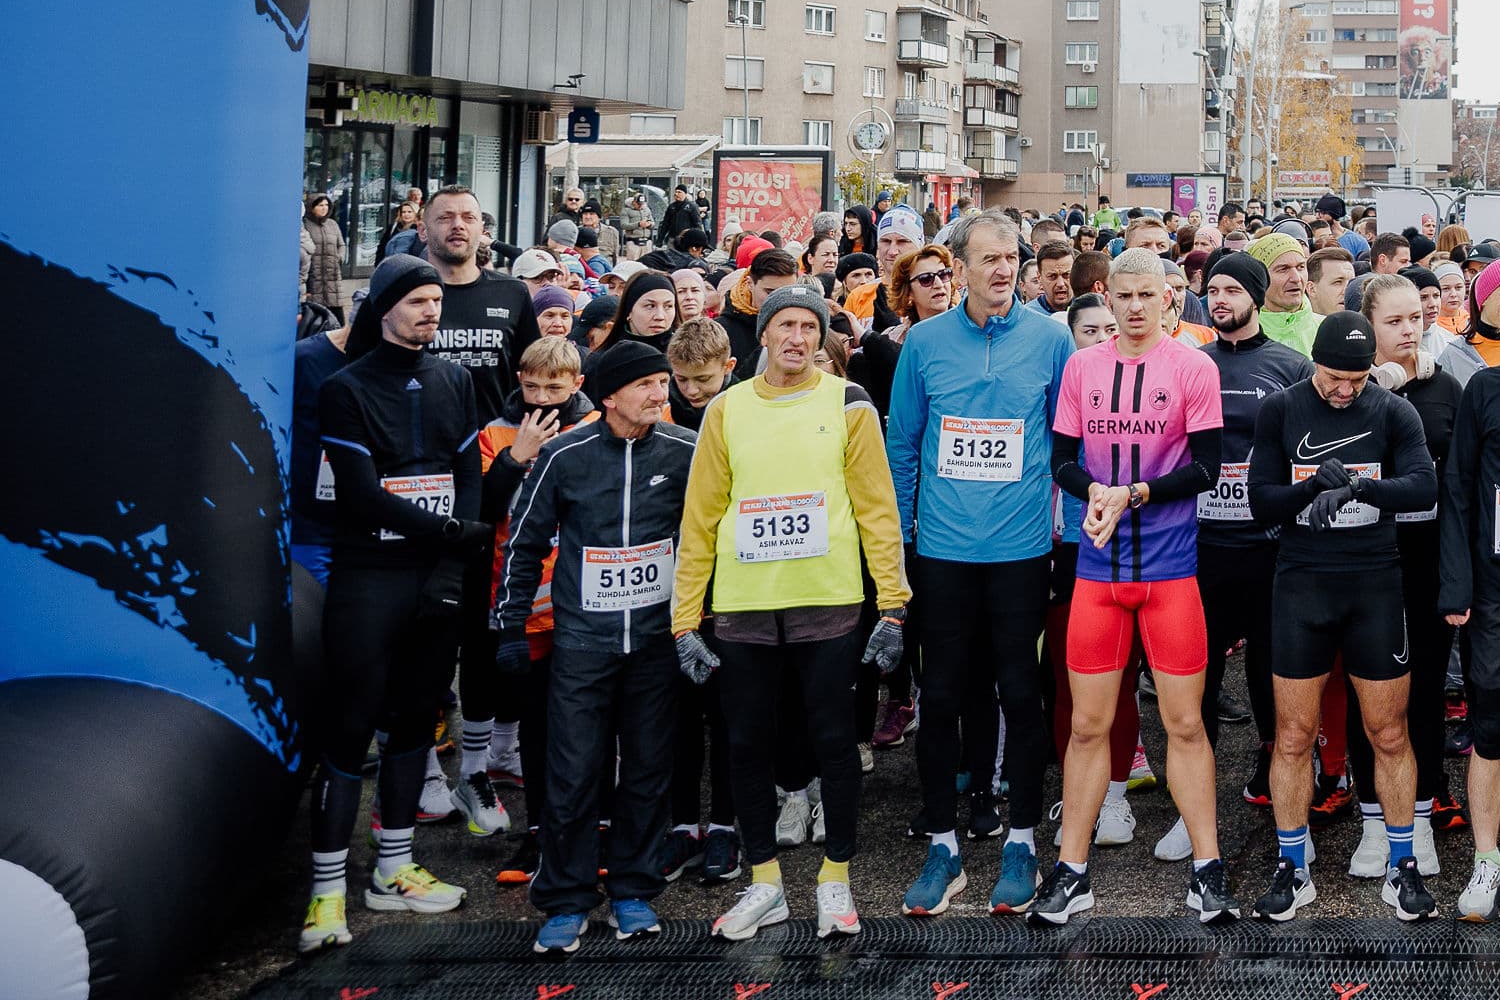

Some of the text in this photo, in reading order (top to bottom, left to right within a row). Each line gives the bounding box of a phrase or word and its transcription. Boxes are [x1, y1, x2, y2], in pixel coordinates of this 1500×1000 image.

[726, 171, 791, 189] OKUSI
[726, 188, 783, 207] SVOJ
[1087, 419, 1168, 435] GERMANY
[952, 437, 1007, 459] 5132
[1206, 501, 1223, 509] AMAR
[752, 513, 811, 538] 5133
[759, 537, 806, 549] ASIM KAVAZ
[600, 563, 659, 589] 5130
[597, 590, 631, 599] ZUHDIJA
